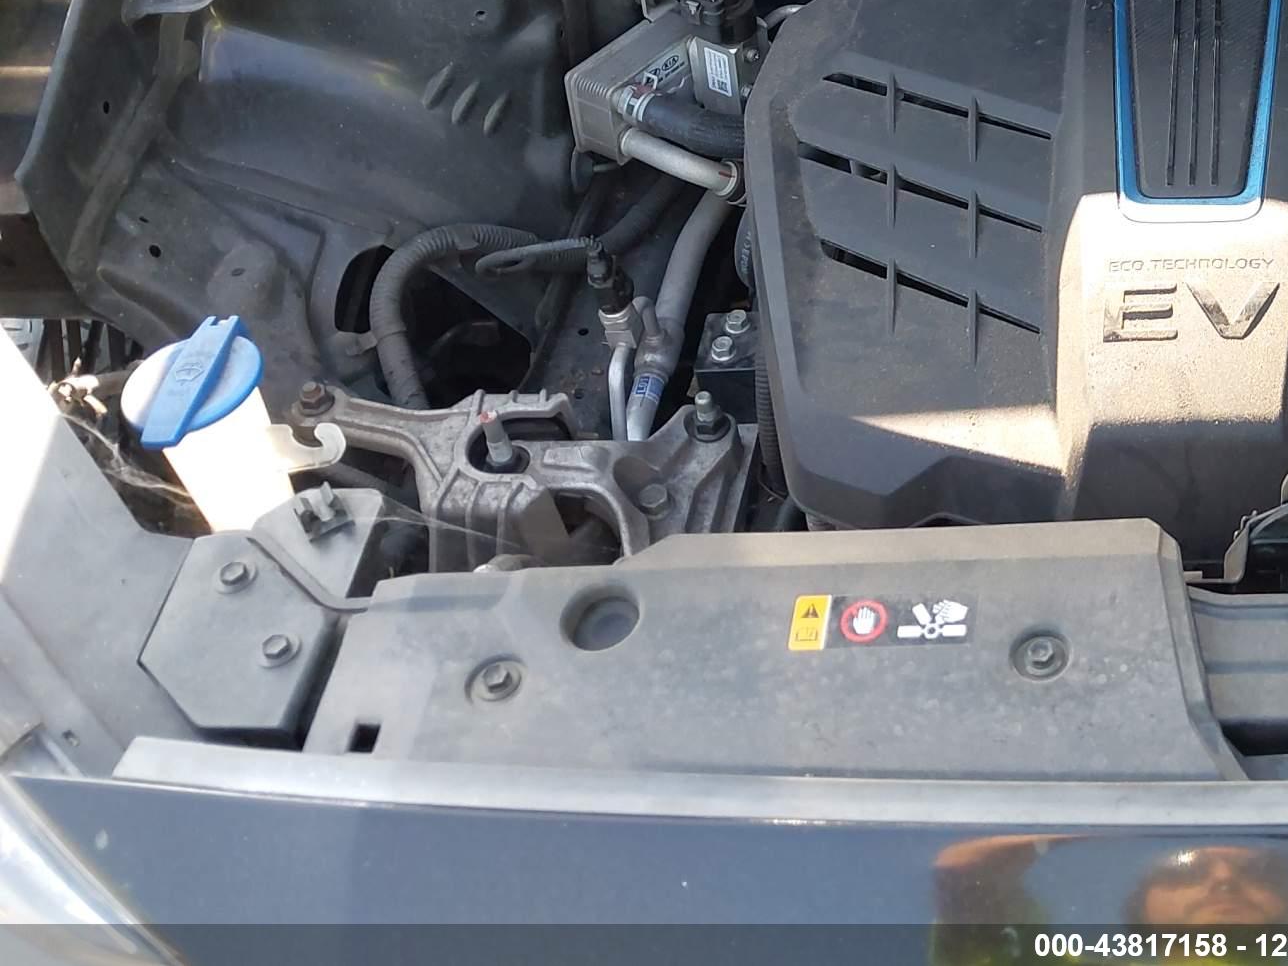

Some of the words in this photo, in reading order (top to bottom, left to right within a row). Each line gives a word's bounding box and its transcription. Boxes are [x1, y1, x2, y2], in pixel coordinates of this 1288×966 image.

[1109, 260, 1145, 272] ECO
[1151, 258, 1275, 270] TECHNOLOGY
[1103, 282, 1280, 343] EV
